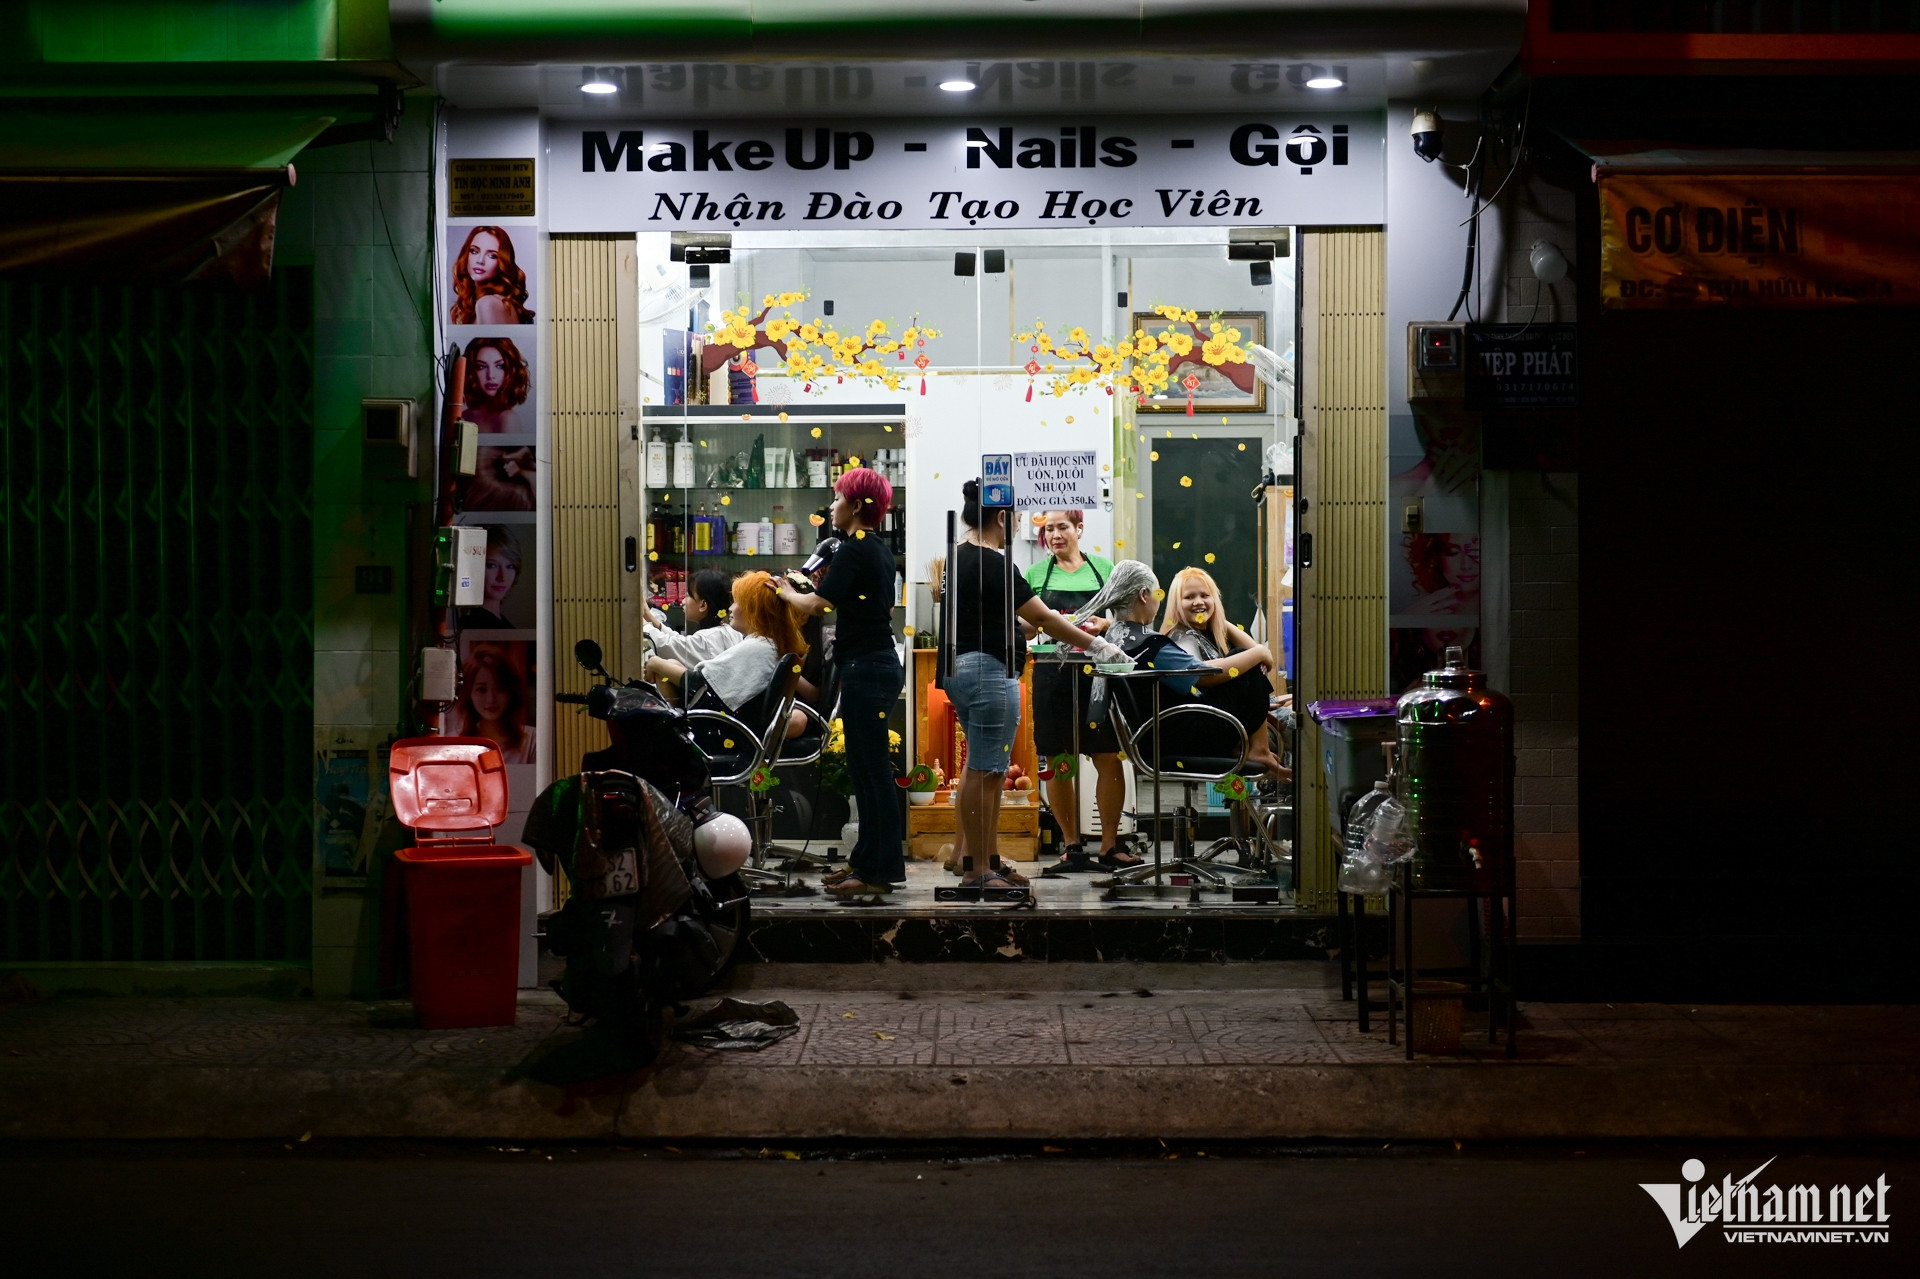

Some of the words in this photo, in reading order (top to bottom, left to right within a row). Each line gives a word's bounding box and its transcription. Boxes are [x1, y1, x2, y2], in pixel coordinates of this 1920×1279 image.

[966, 126, 1138, 169] Nails
[1229, 123, 1349, 175] Gội
[648, 192, 786, 227] Nhận
[803, 191, 903, 221] Đào
[929, 191, 1019, 226] Tạo
[1038, 190, 1134, 226] Học
[1154, 188, 1264, 218] Viên
[1625, 202, 1686, 253] CƠ
[1695, 197, 1799, 264] ĐIỆN
[1522, 344, 1574, 376] PHÁT
[1031, 455, 1047, 467] ĐÃI
[1050, 455, 1070, 469] HỌC
[1072, 455, 1094, 466] SINH
[1034, 481, 1076, 494] NHUỘM
[1049, 494, 1067, 505] GIÁ
